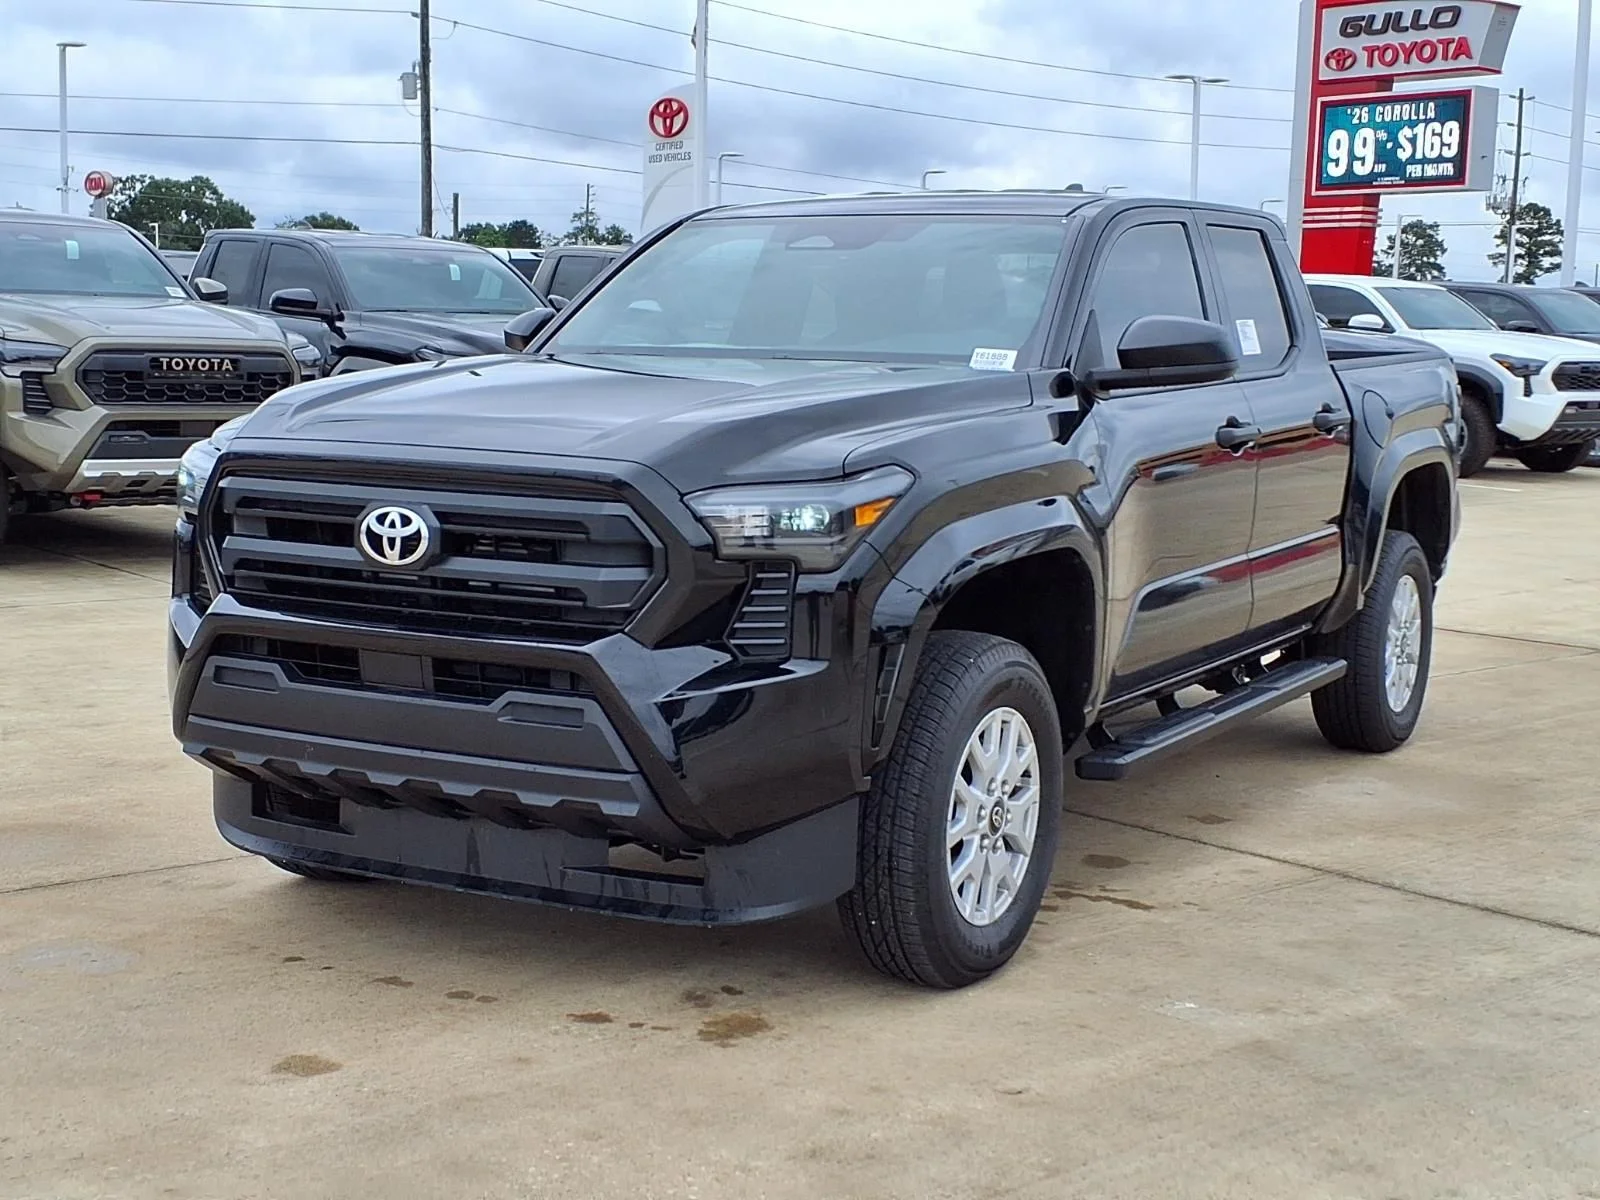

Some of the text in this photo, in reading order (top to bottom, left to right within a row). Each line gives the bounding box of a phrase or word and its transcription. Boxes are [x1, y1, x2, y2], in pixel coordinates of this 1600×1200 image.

[1339, 5, 1462, 38] GULLO
[1362, 36, 1473, 68] TOYOTA
[1347, 101, 1436, 125] '26 COROLLA
[655, 140, 684, 152] CERTIFIED
[1396, 121, 1460, 161] $169
[648, 151, 692, 164] USED VEHICLES
[1406, 162, 1454, 178] PER MONTH
[159, 357, 234, 372] TOYOTA
